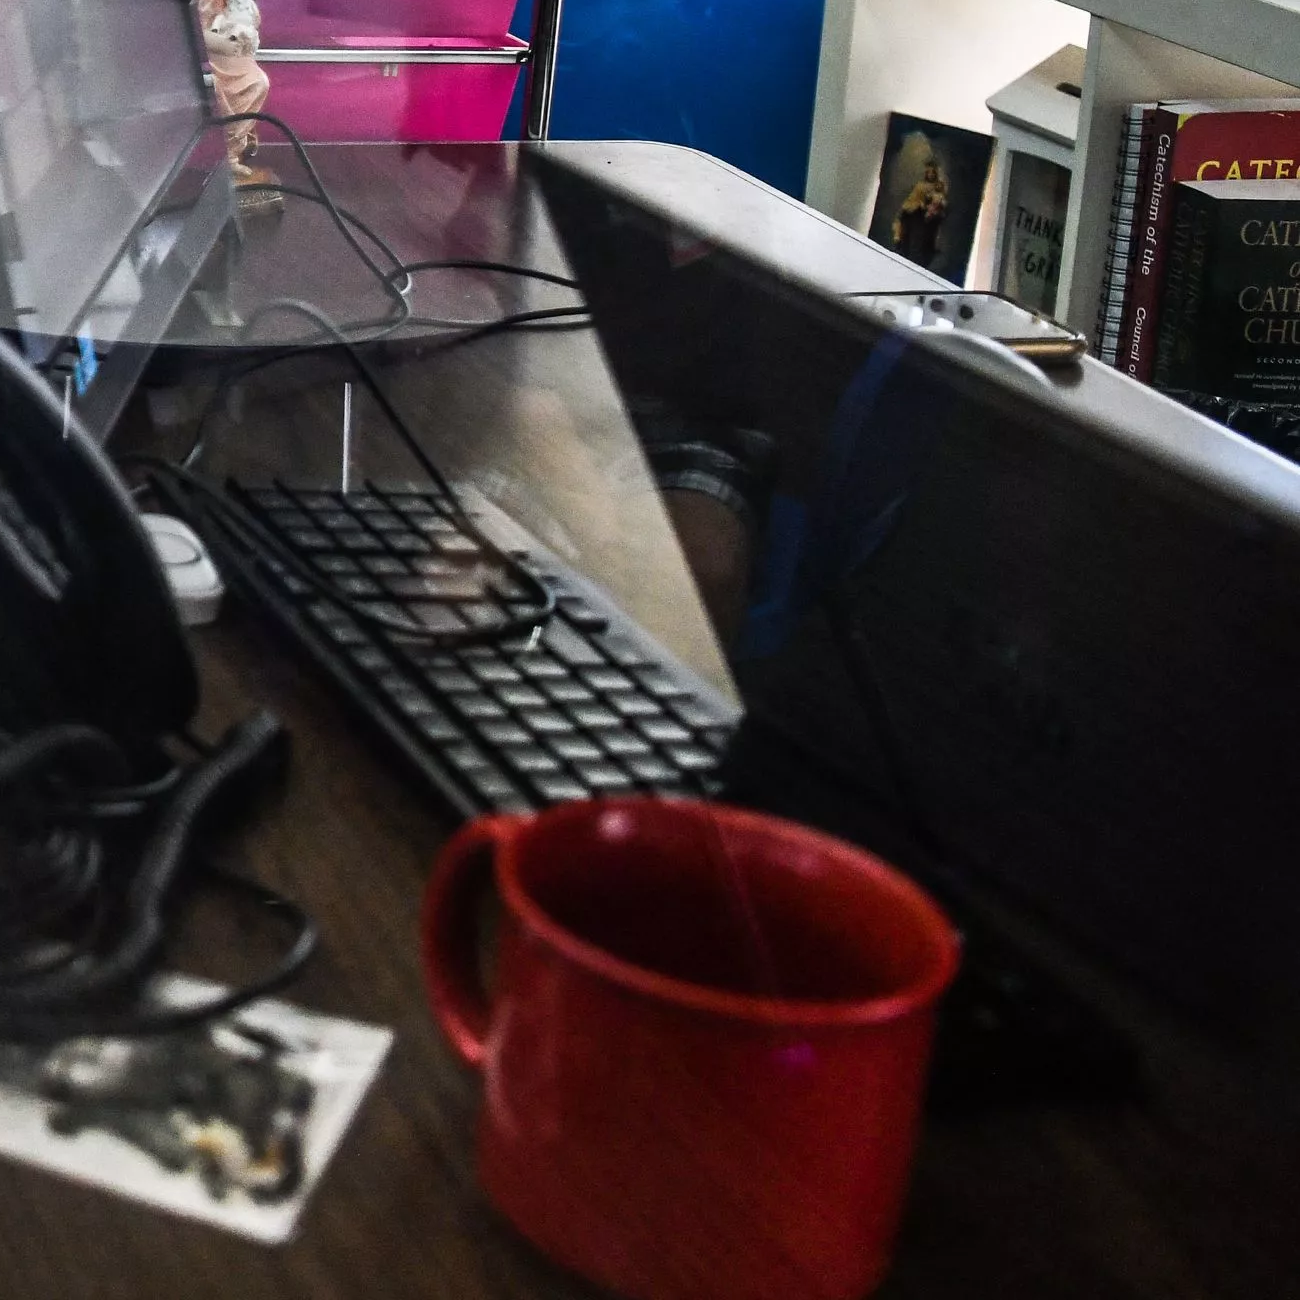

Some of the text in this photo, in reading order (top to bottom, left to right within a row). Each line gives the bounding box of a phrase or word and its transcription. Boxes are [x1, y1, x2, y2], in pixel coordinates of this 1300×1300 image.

[1149, 134, 1172, 222] Catechism
[1196, 159, 1300, 181] CATE
[1145, 226, 1157, 246] of
[1141, 249, 1156, 276] the
[1129, 307, 1147, 361] Council
